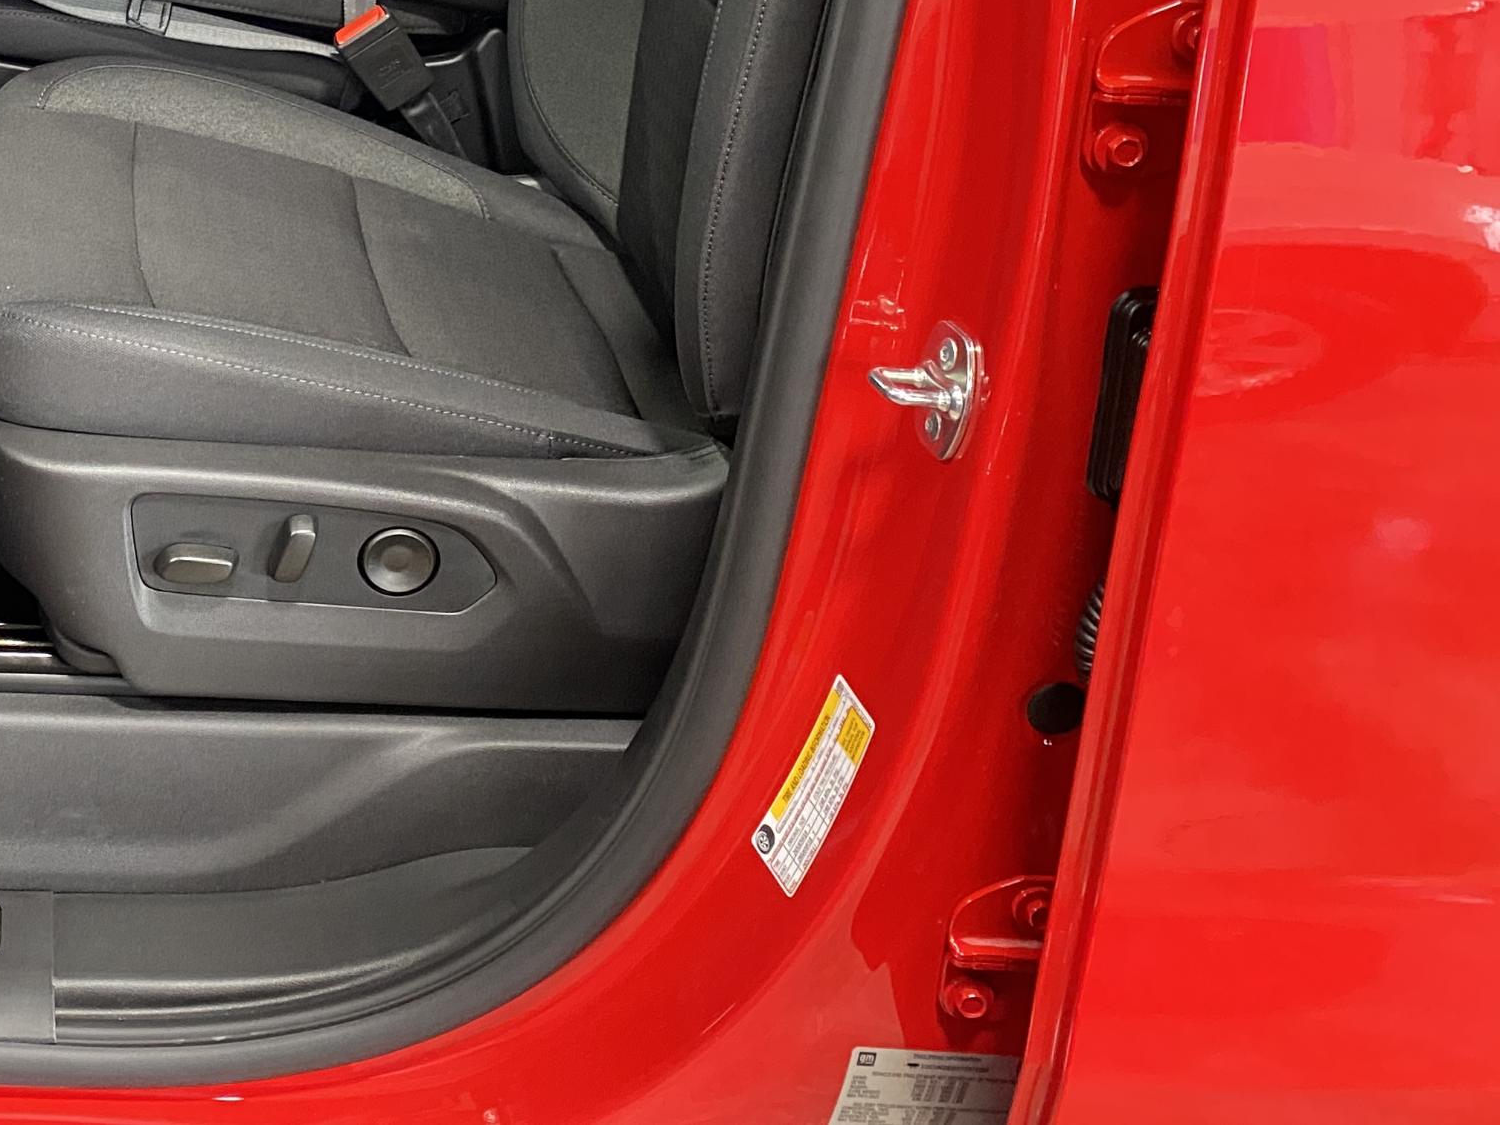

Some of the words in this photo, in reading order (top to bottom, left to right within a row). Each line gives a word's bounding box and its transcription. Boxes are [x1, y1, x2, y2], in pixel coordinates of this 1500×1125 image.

[789, 776, 799, 790] AND
[797, 751, 812, 780] LOADING
[809, 715, 831, 754] INFORMATION
